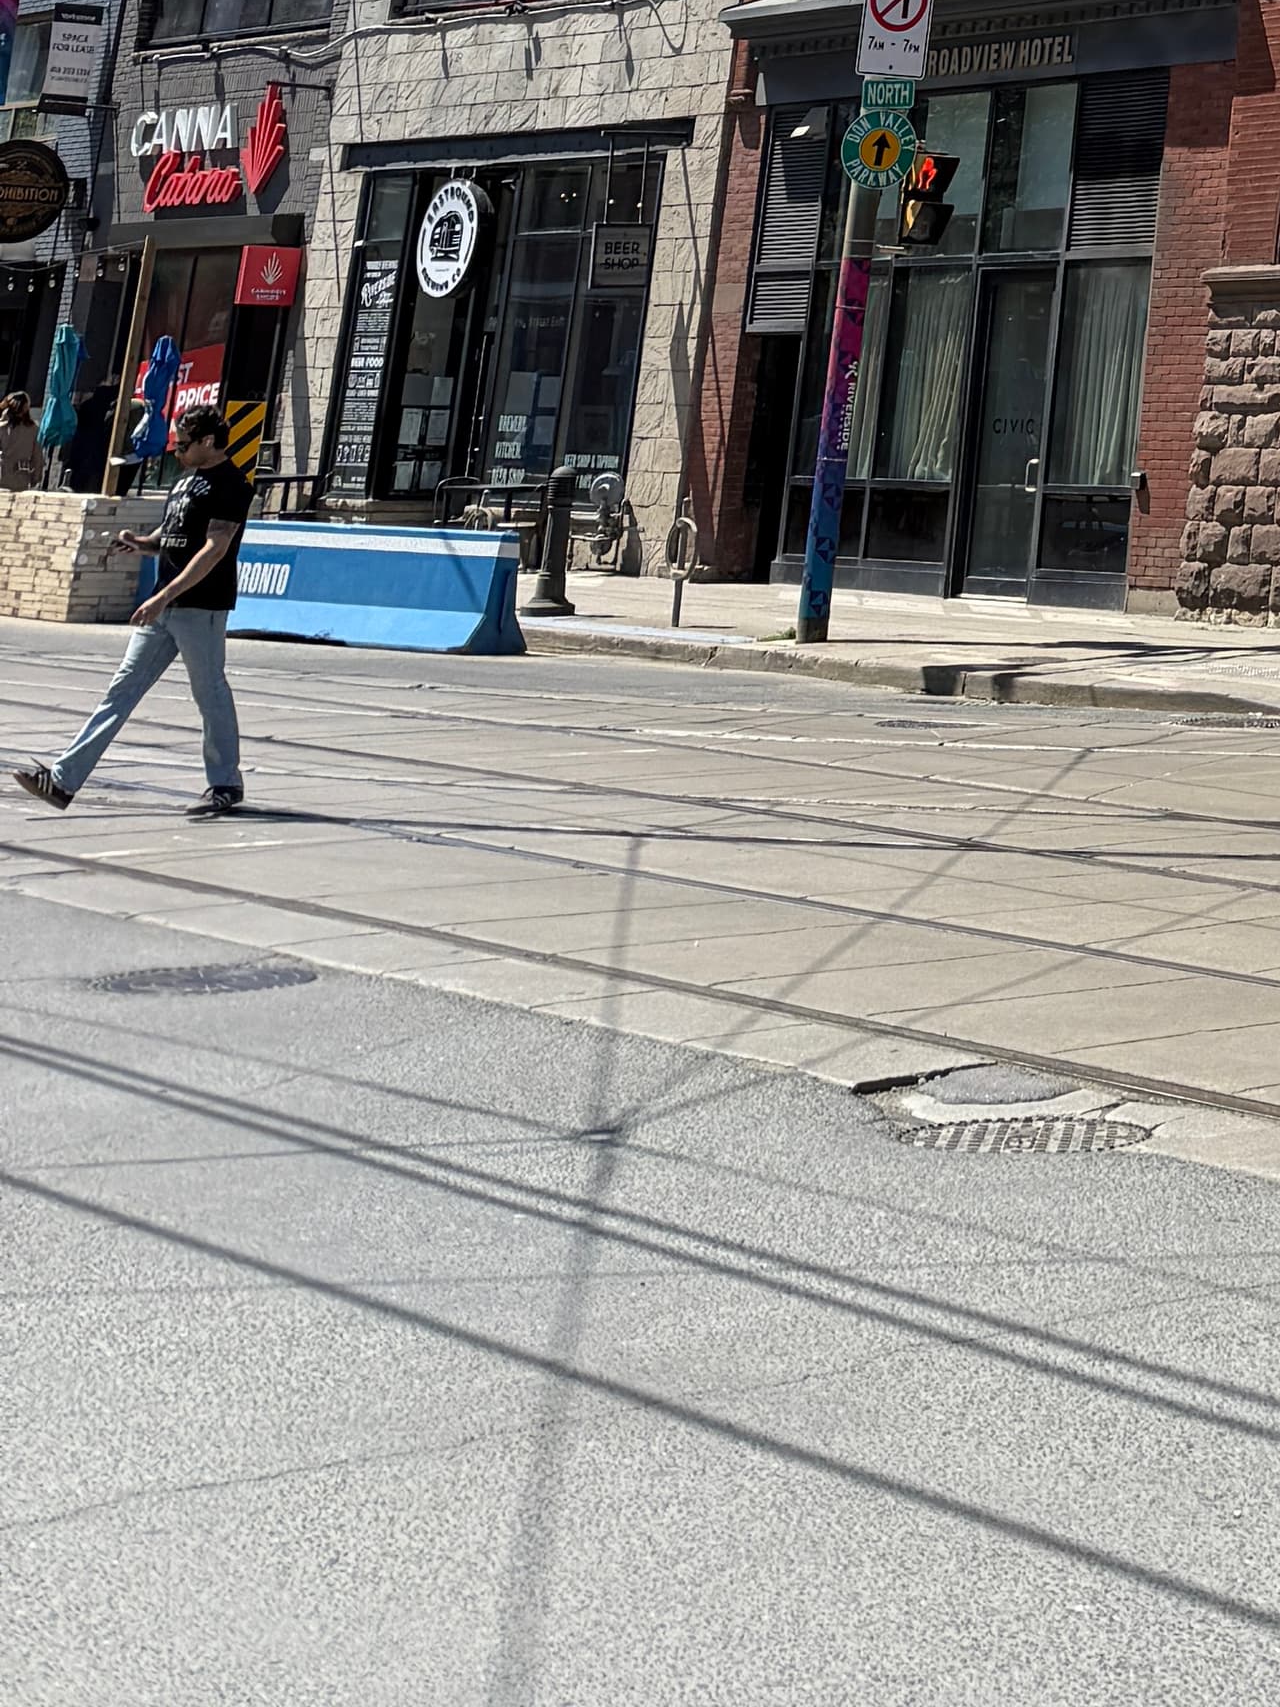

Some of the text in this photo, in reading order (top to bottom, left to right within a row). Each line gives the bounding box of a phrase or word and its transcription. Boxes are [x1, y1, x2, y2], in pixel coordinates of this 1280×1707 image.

[868, 36, 884, 51] 7AM
[903, 39, 920, 54] 7PM
[928, 35, 1073, 77] ROADVIEW HOTEL
[867, 82, 910, 105] NORTH
[130, 102, 238, 157] CANNA
[847, 111, 916, 153] DON VALLEY
[142, 149, 243, 214] Cabana
[846, 157, 905, 187] PARKWAY
[0, 186, 58, 202] HIBITION
[604, 242, 640, 255] BEER
[604, 258, 639, 270] SHOP
[174, 382, 221, 413] PRICE
[841, 381, 857, 452] RIVERSIDE
[992, 418, 1034, 435] CIVIC
[237, 561, 291, 596] RONTO
